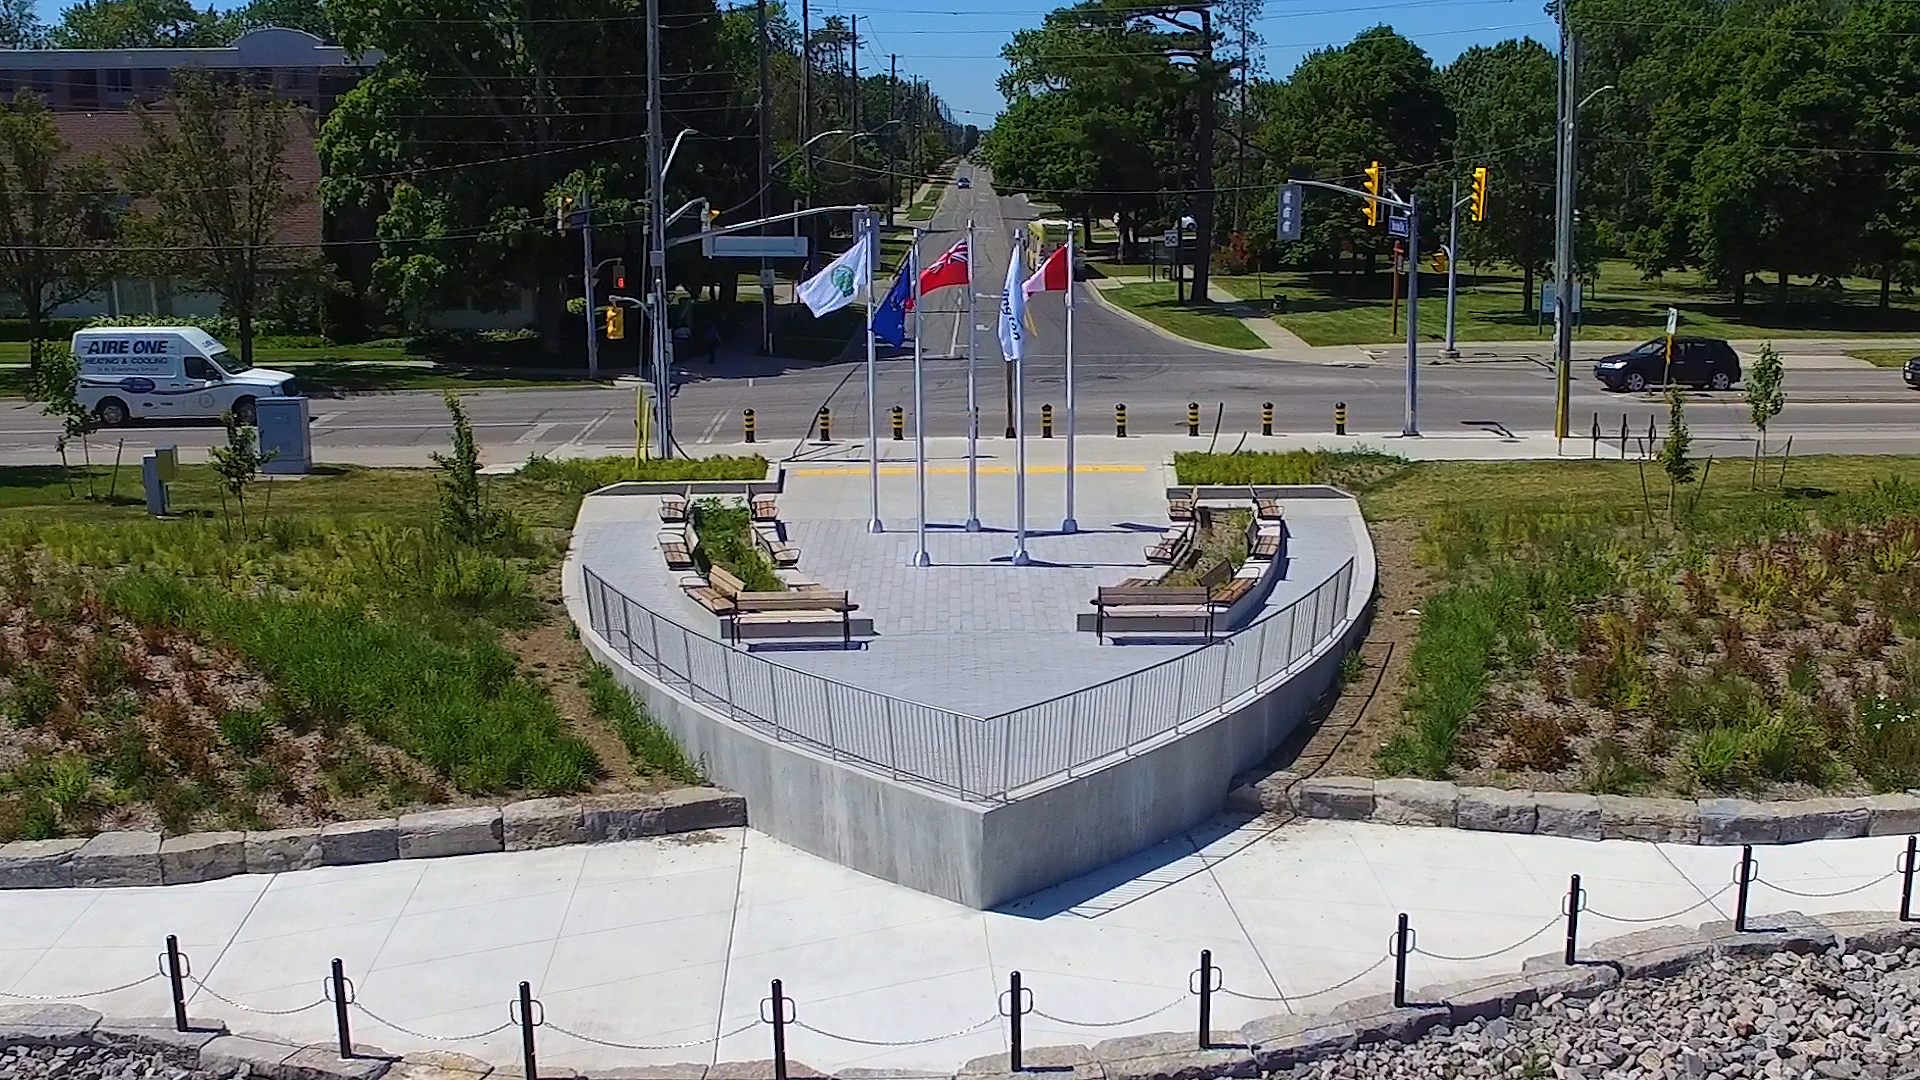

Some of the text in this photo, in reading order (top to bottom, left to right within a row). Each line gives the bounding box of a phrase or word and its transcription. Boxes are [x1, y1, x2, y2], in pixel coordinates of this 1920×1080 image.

[1165, 235, 1176, 244] 50
[87, 340, 168, 354] AIRE ONE
